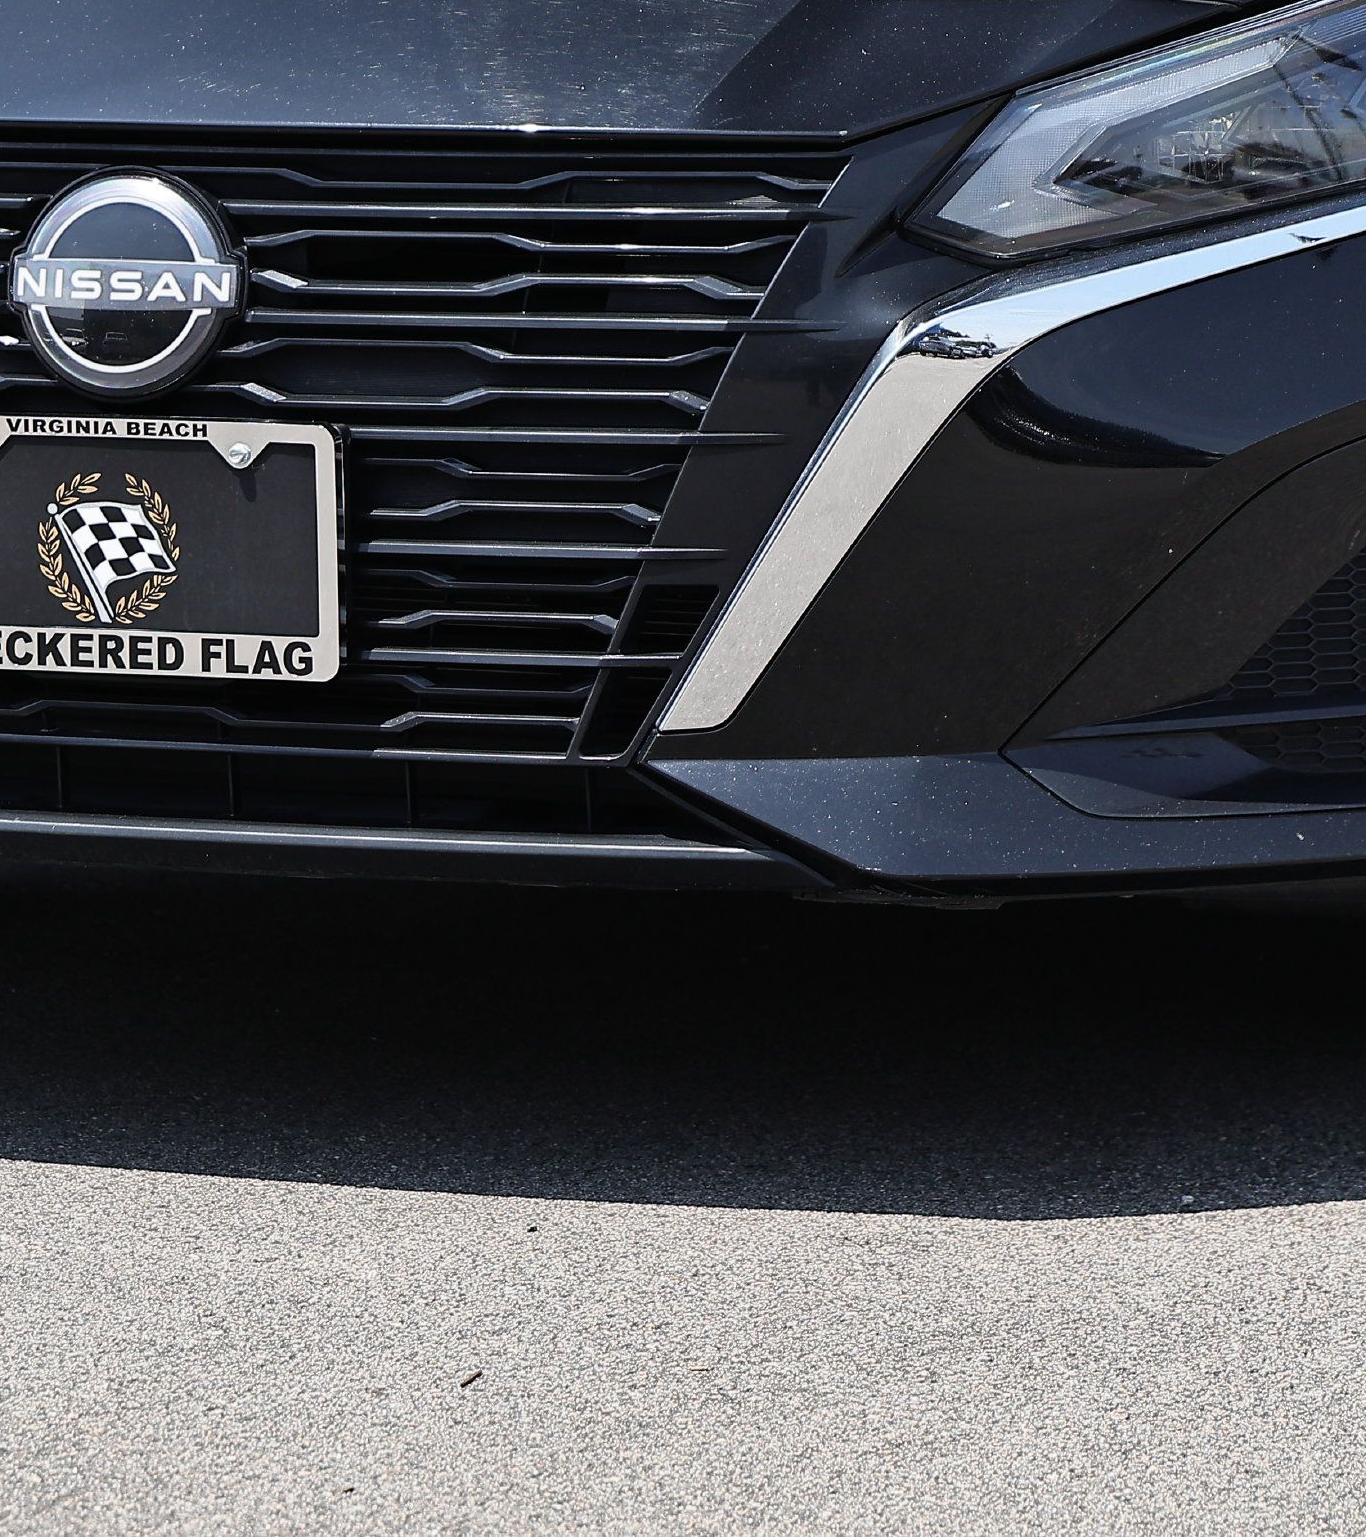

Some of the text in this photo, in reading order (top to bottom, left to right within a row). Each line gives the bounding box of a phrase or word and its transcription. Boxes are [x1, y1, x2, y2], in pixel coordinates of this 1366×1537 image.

[17, 267, 231, 302] NISSAN
[6, 418, 209, 438] VIRGINIA BEACH
[201, 637, 314, 676] FLAG
